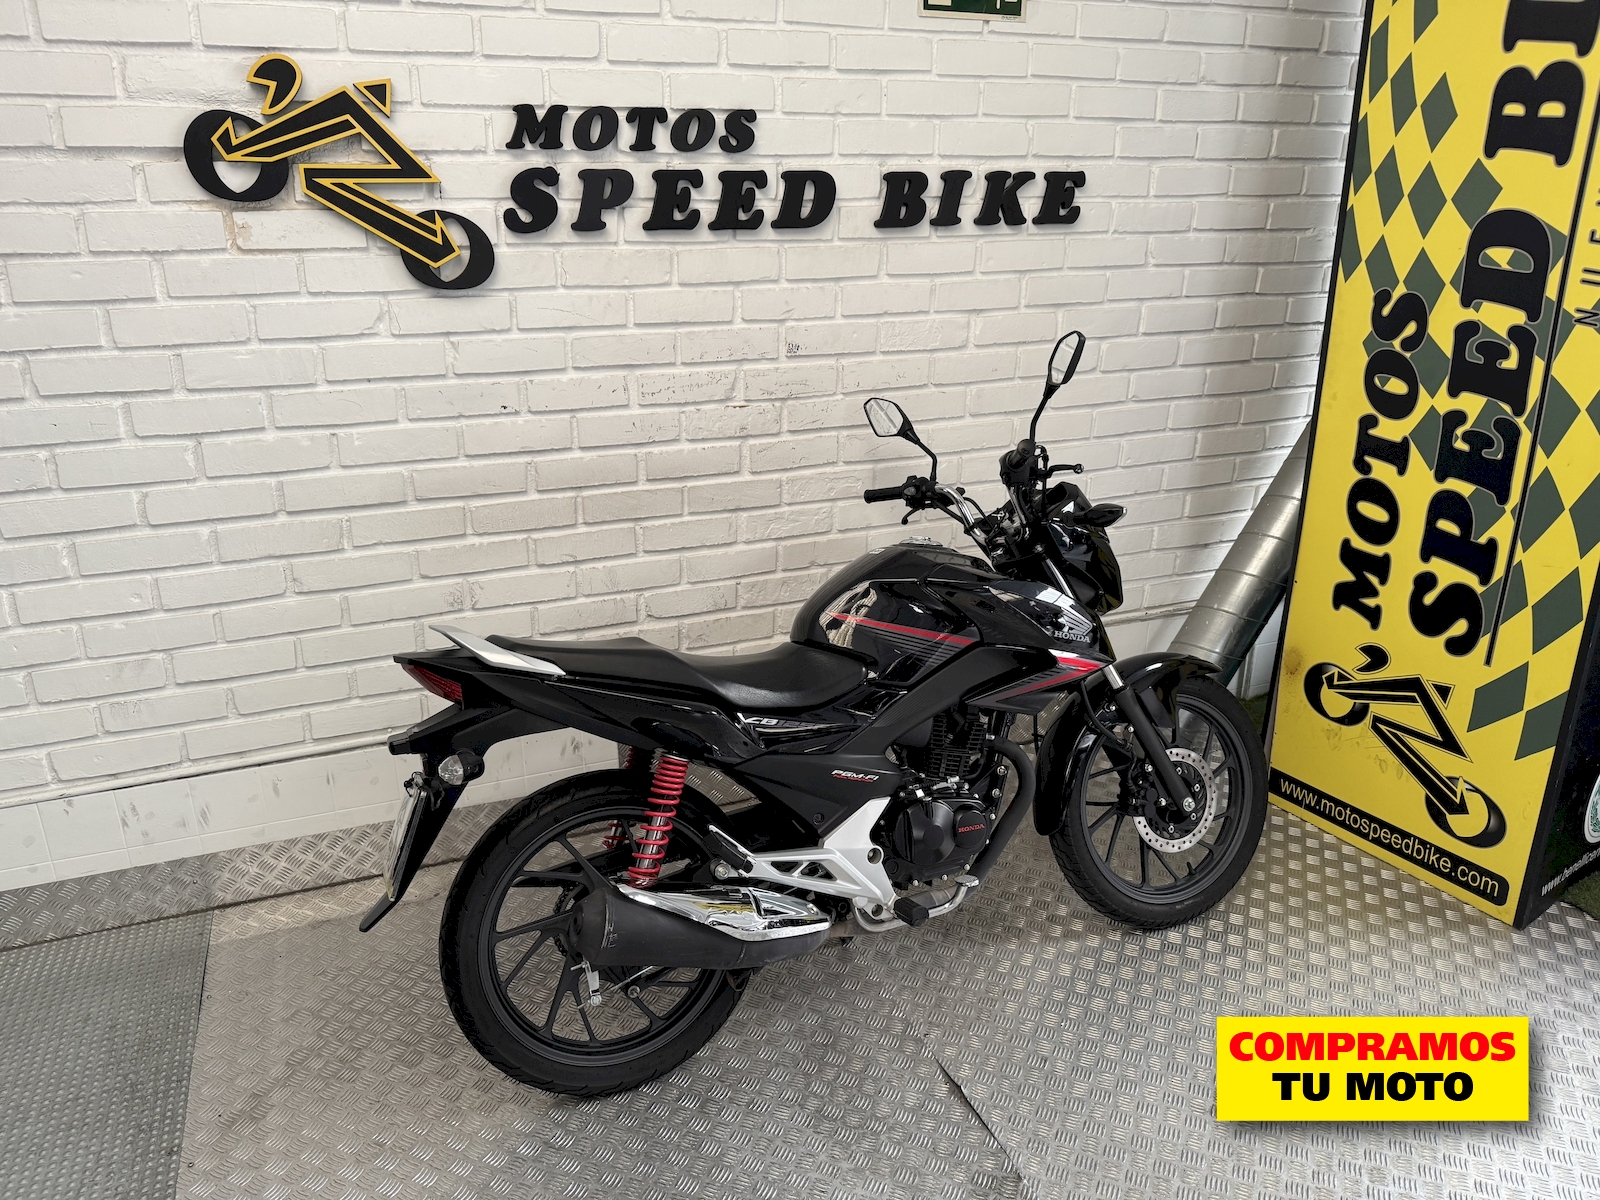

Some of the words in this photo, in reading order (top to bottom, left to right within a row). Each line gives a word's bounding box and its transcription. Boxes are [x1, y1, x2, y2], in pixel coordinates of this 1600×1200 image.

[505, 103, 758, 153] MOTOS
[503, 167, 837, 233] SPEED
[874, 170, 1086, 229] BIKE
[1332, 286, 1430, 631] MOTOS
[1408, 208, 1552, 658] SPEED
[1053, 630, 1091, 643] HONDA
[958, 823, 985, 833] HONDA
[1280, 777, 1500, 898] www.motospeedbike.com
